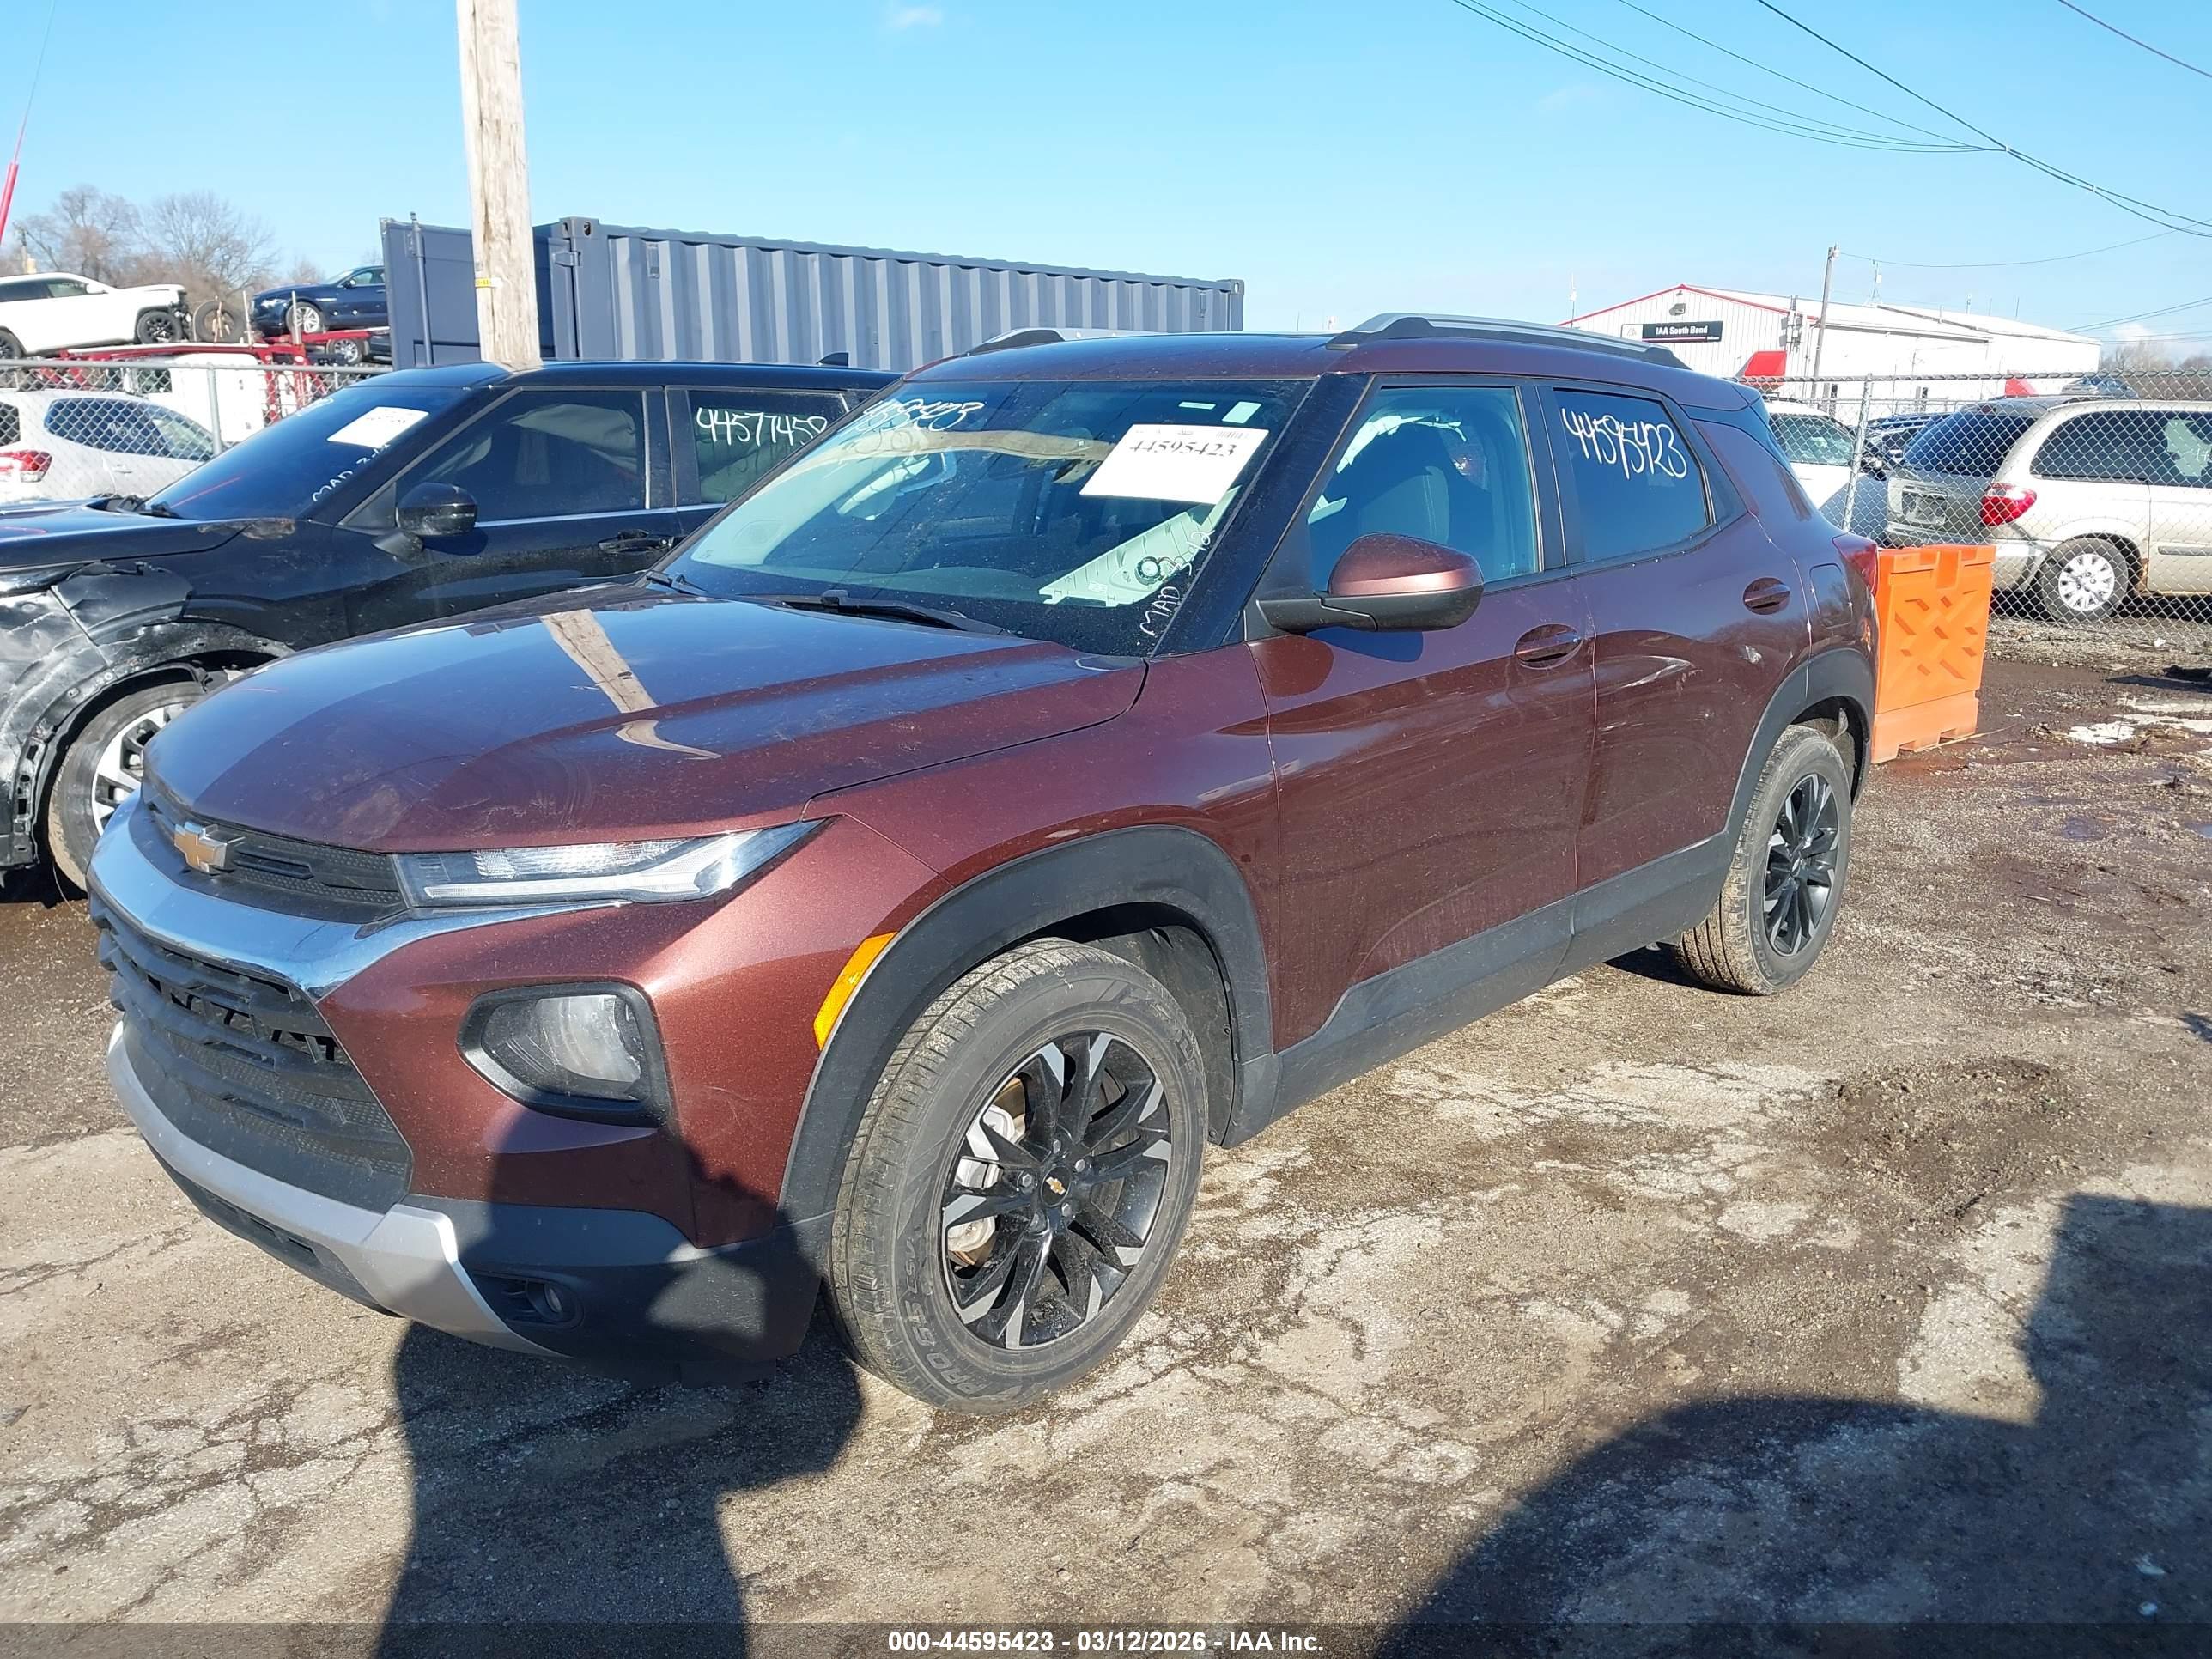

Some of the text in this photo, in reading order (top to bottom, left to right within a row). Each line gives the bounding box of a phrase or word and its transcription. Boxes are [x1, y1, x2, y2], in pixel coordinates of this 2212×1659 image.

[1656, 325, 1709, 335] IAA South Bend
[1129, 440, 1237, 457] 44595423
[1139, 586, 1182, 636] MAD
